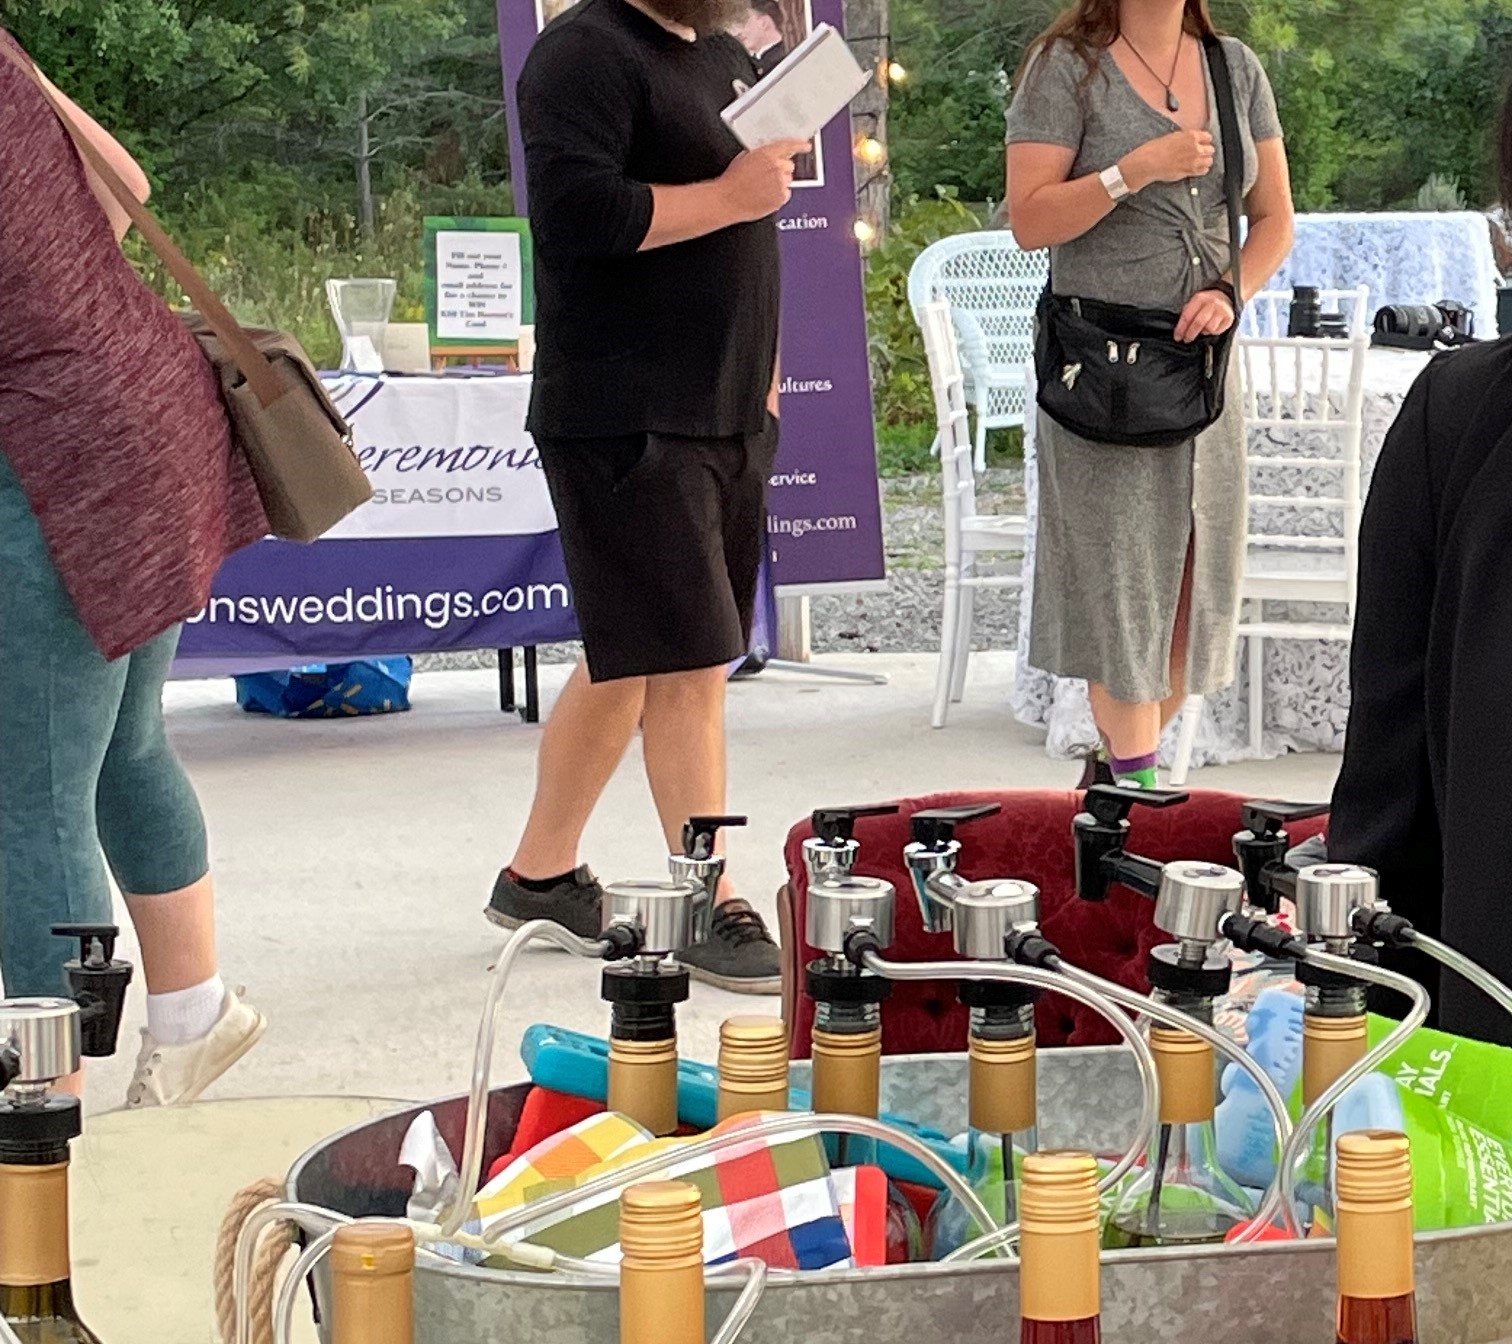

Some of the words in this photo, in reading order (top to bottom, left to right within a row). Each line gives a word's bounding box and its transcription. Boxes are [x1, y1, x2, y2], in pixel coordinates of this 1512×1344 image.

[777, 213, 828, 230] cation
[778, 377, 832, 394] ultures
[358, 444, 544, 473] eremoni
[768, 468, 817, 486] ervice
[372, 486, 503, 504] SEASONS
[767, 515, 857, 538] ings.com
